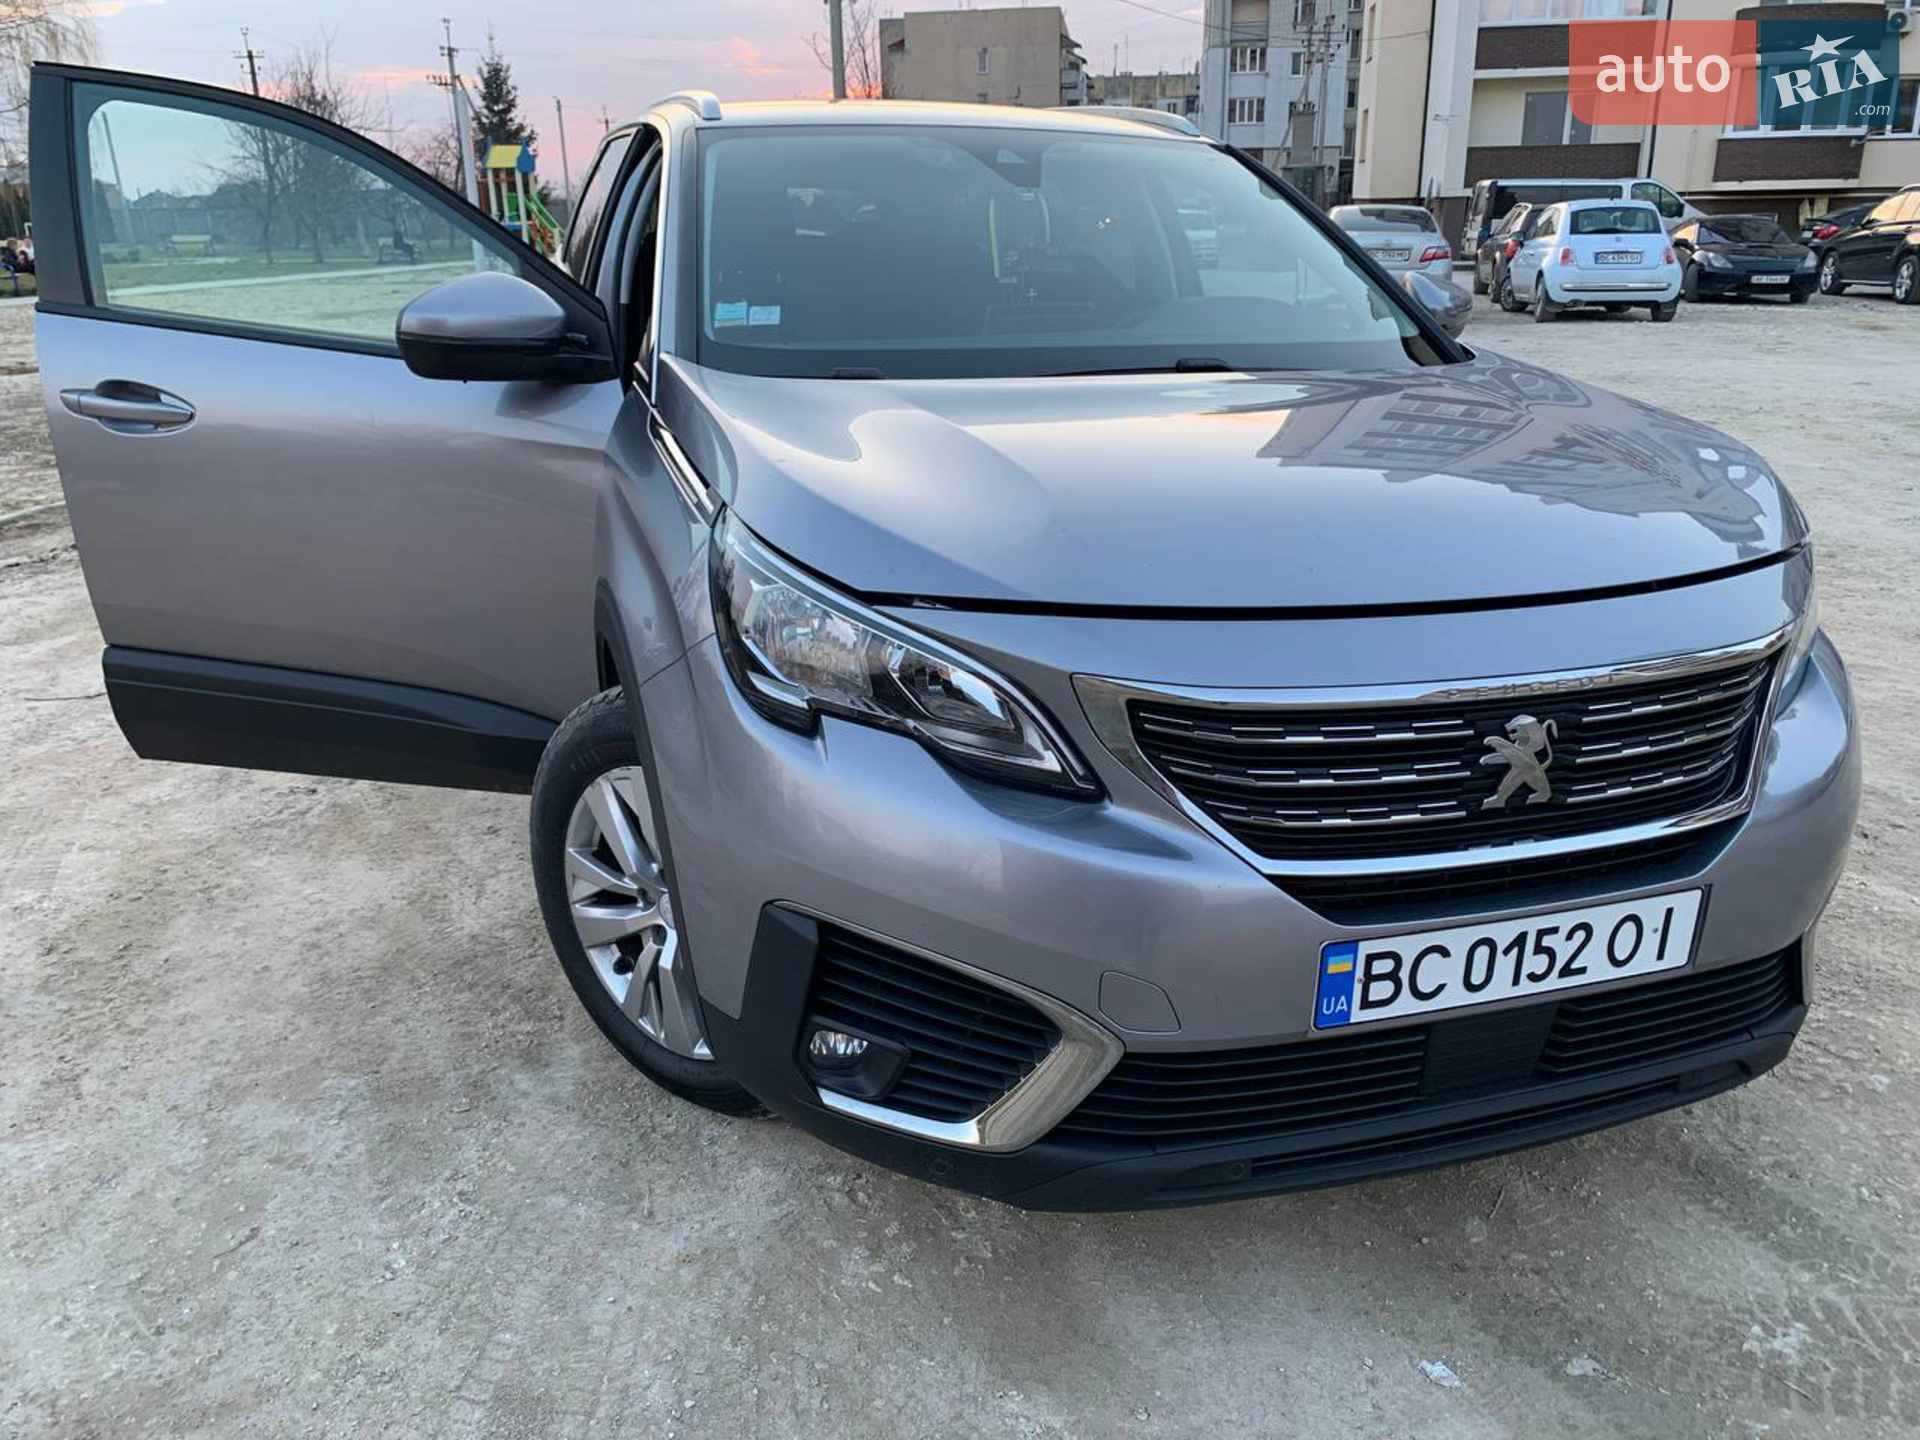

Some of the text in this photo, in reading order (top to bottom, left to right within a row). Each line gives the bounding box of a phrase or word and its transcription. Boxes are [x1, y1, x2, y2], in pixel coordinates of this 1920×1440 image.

[1358, 944, 1452, 1011] BC
[1462, 921, 1594, 994] 0152
[1321, 995, 1349, 1016] UA
